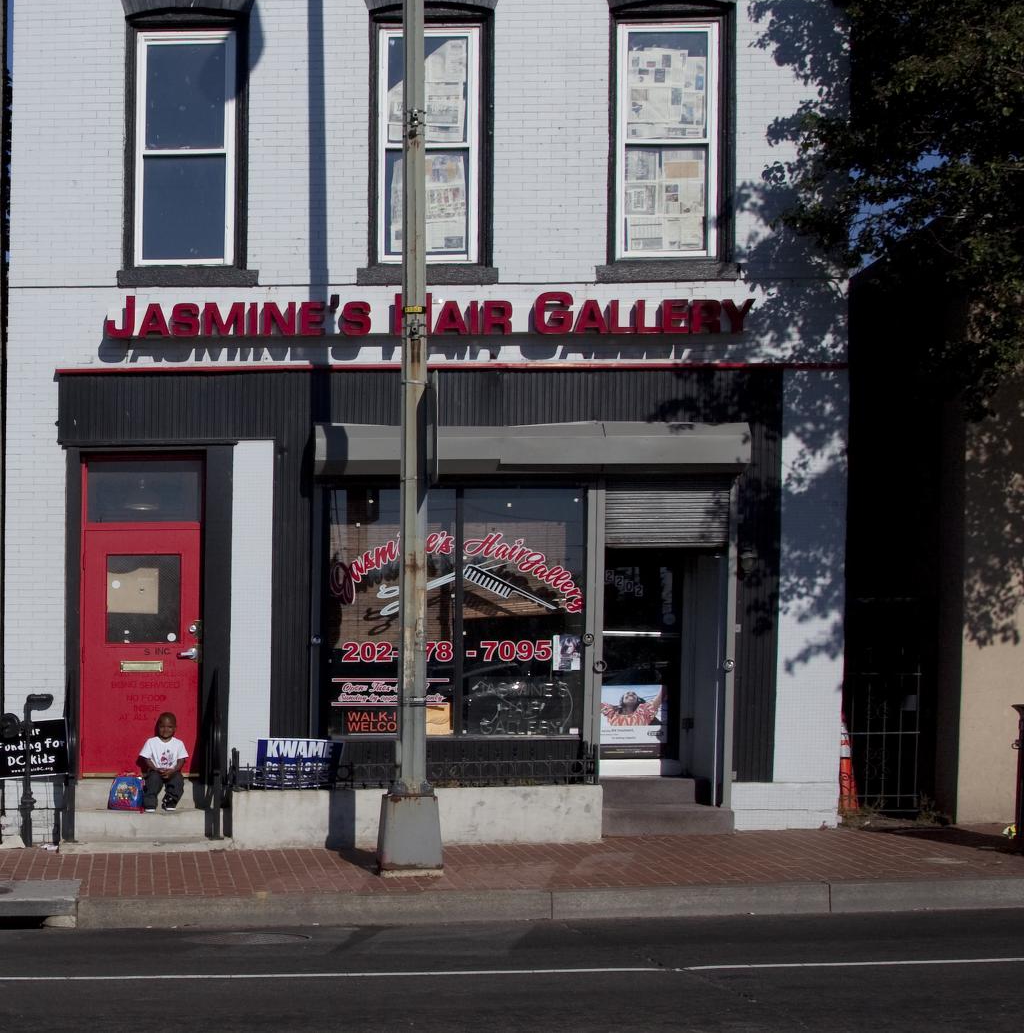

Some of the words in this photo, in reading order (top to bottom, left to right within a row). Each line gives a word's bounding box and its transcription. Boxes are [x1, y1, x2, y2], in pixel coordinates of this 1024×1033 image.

[106, 295, 372, 338] JASMINE'S
[533, 291, 756, 335] GALLERY
[266, 740, 334, 758] KWAME
[7, 755, 26, 767] DC
